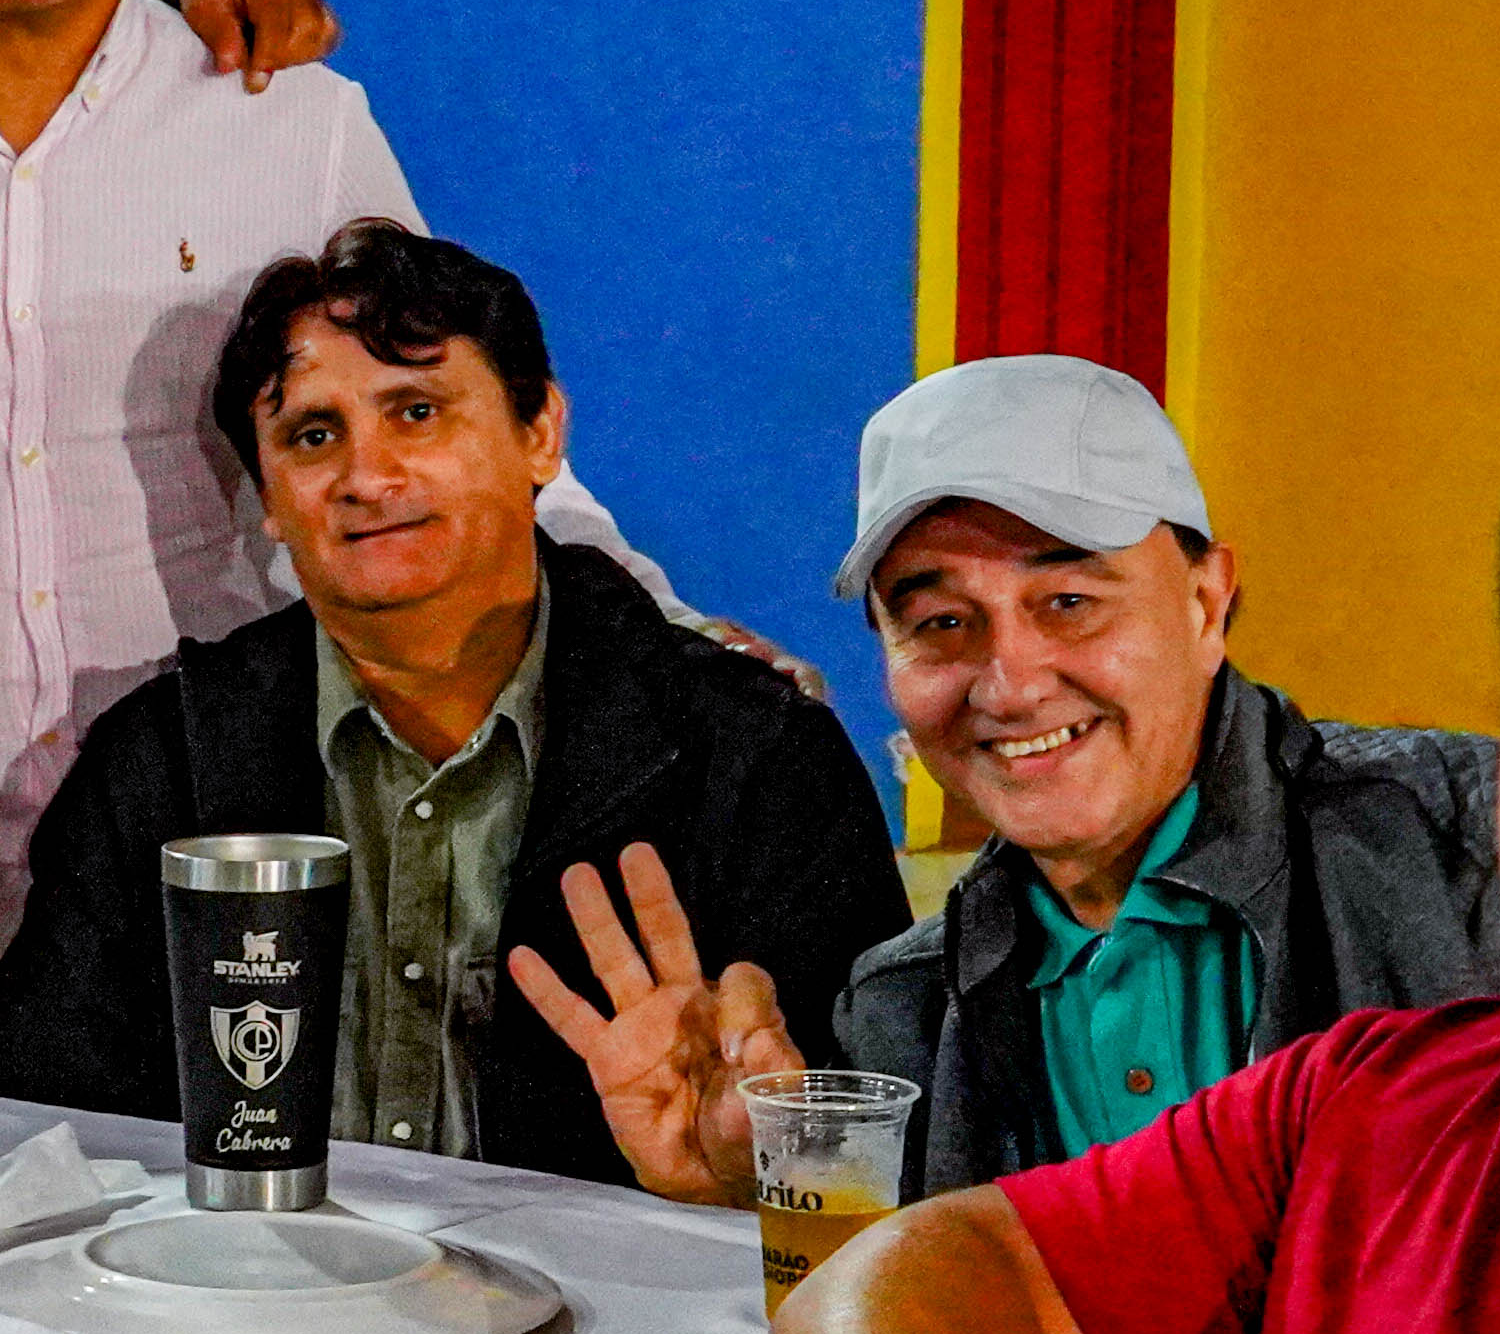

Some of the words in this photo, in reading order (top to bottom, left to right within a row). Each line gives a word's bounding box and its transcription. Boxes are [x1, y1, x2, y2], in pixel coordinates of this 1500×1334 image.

[213, 959, 302, 978] STANLEY
[231, 1100, 278, 1128] Juan
[216, 1127, 292, 1153] Cabrera
